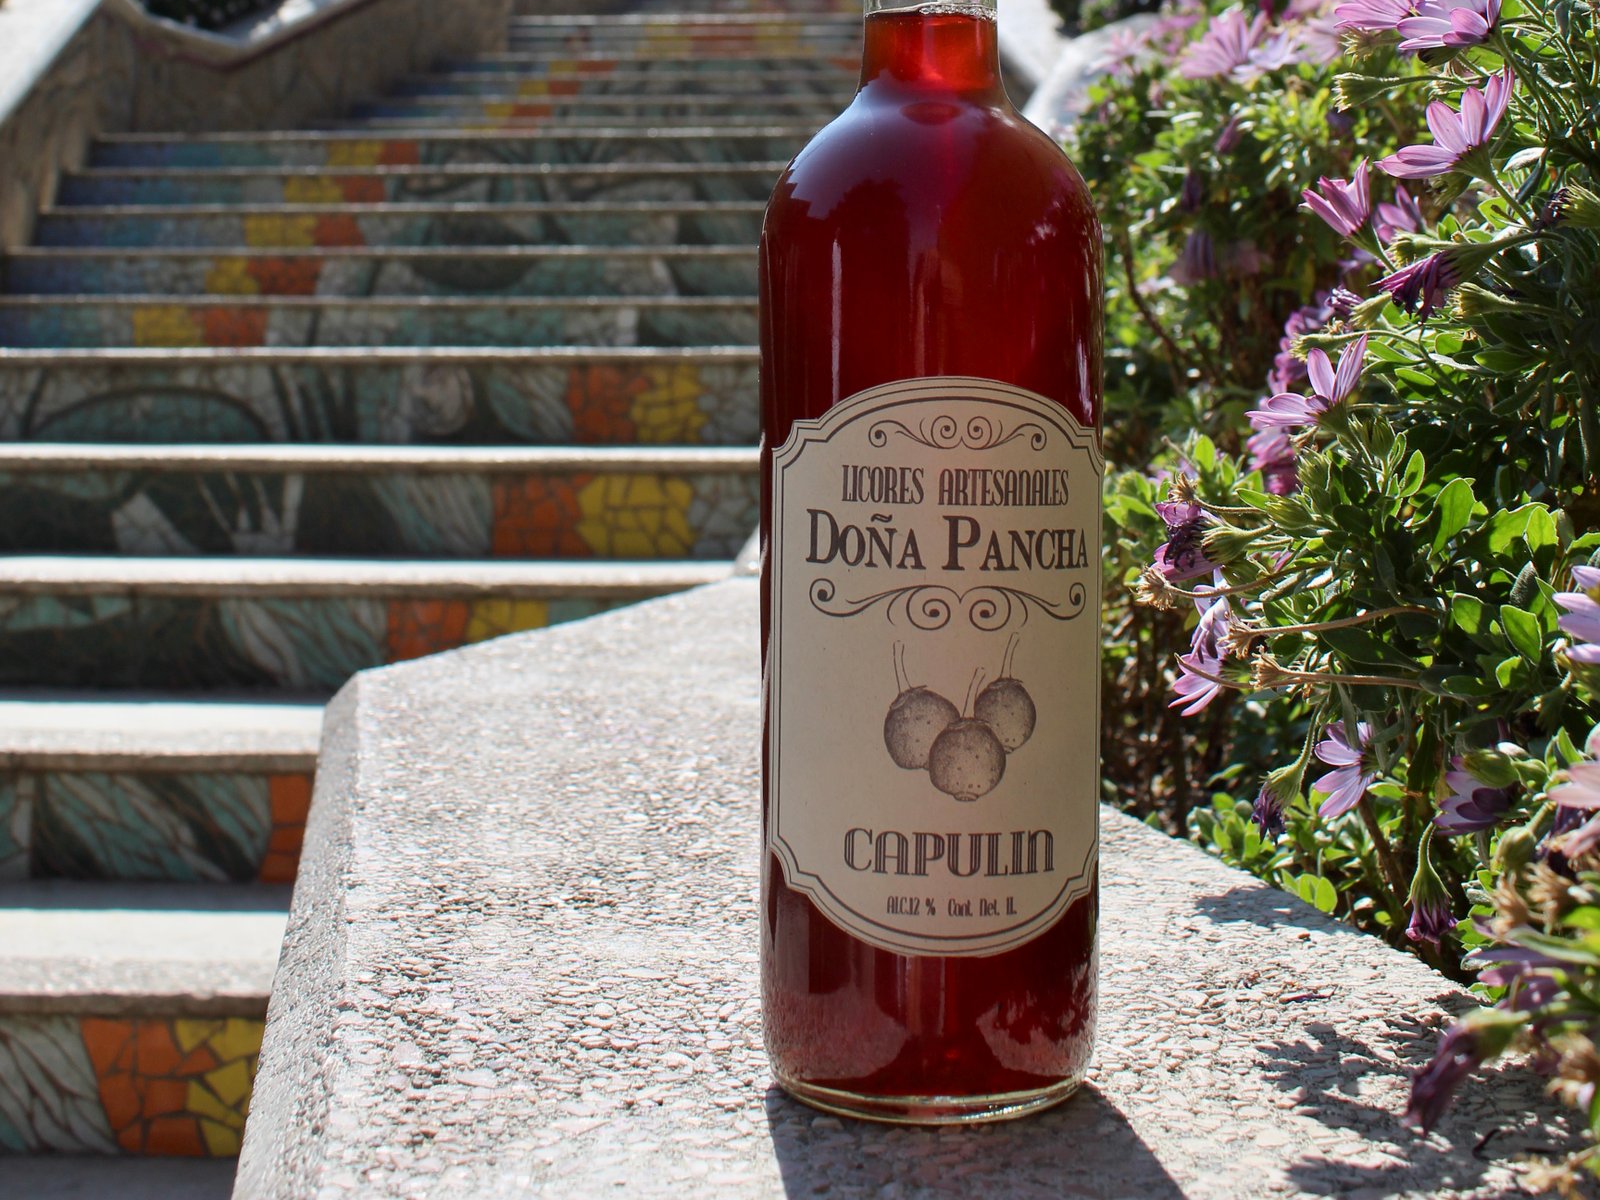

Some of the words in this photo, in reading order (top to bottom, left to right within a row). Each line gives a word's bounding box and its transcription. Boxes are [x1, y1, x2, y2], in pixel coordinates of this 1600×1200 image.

[841, 464, 925, 506] LICORES
[937, 468, 1070, 507] ARTESANALES
[805, 508, 927, 571] DOÑA
[941, 515, 1089, 572] PANCHA
[843, 827, 1055, 877] CAPULIN
[925, 897, 937, 916] %
